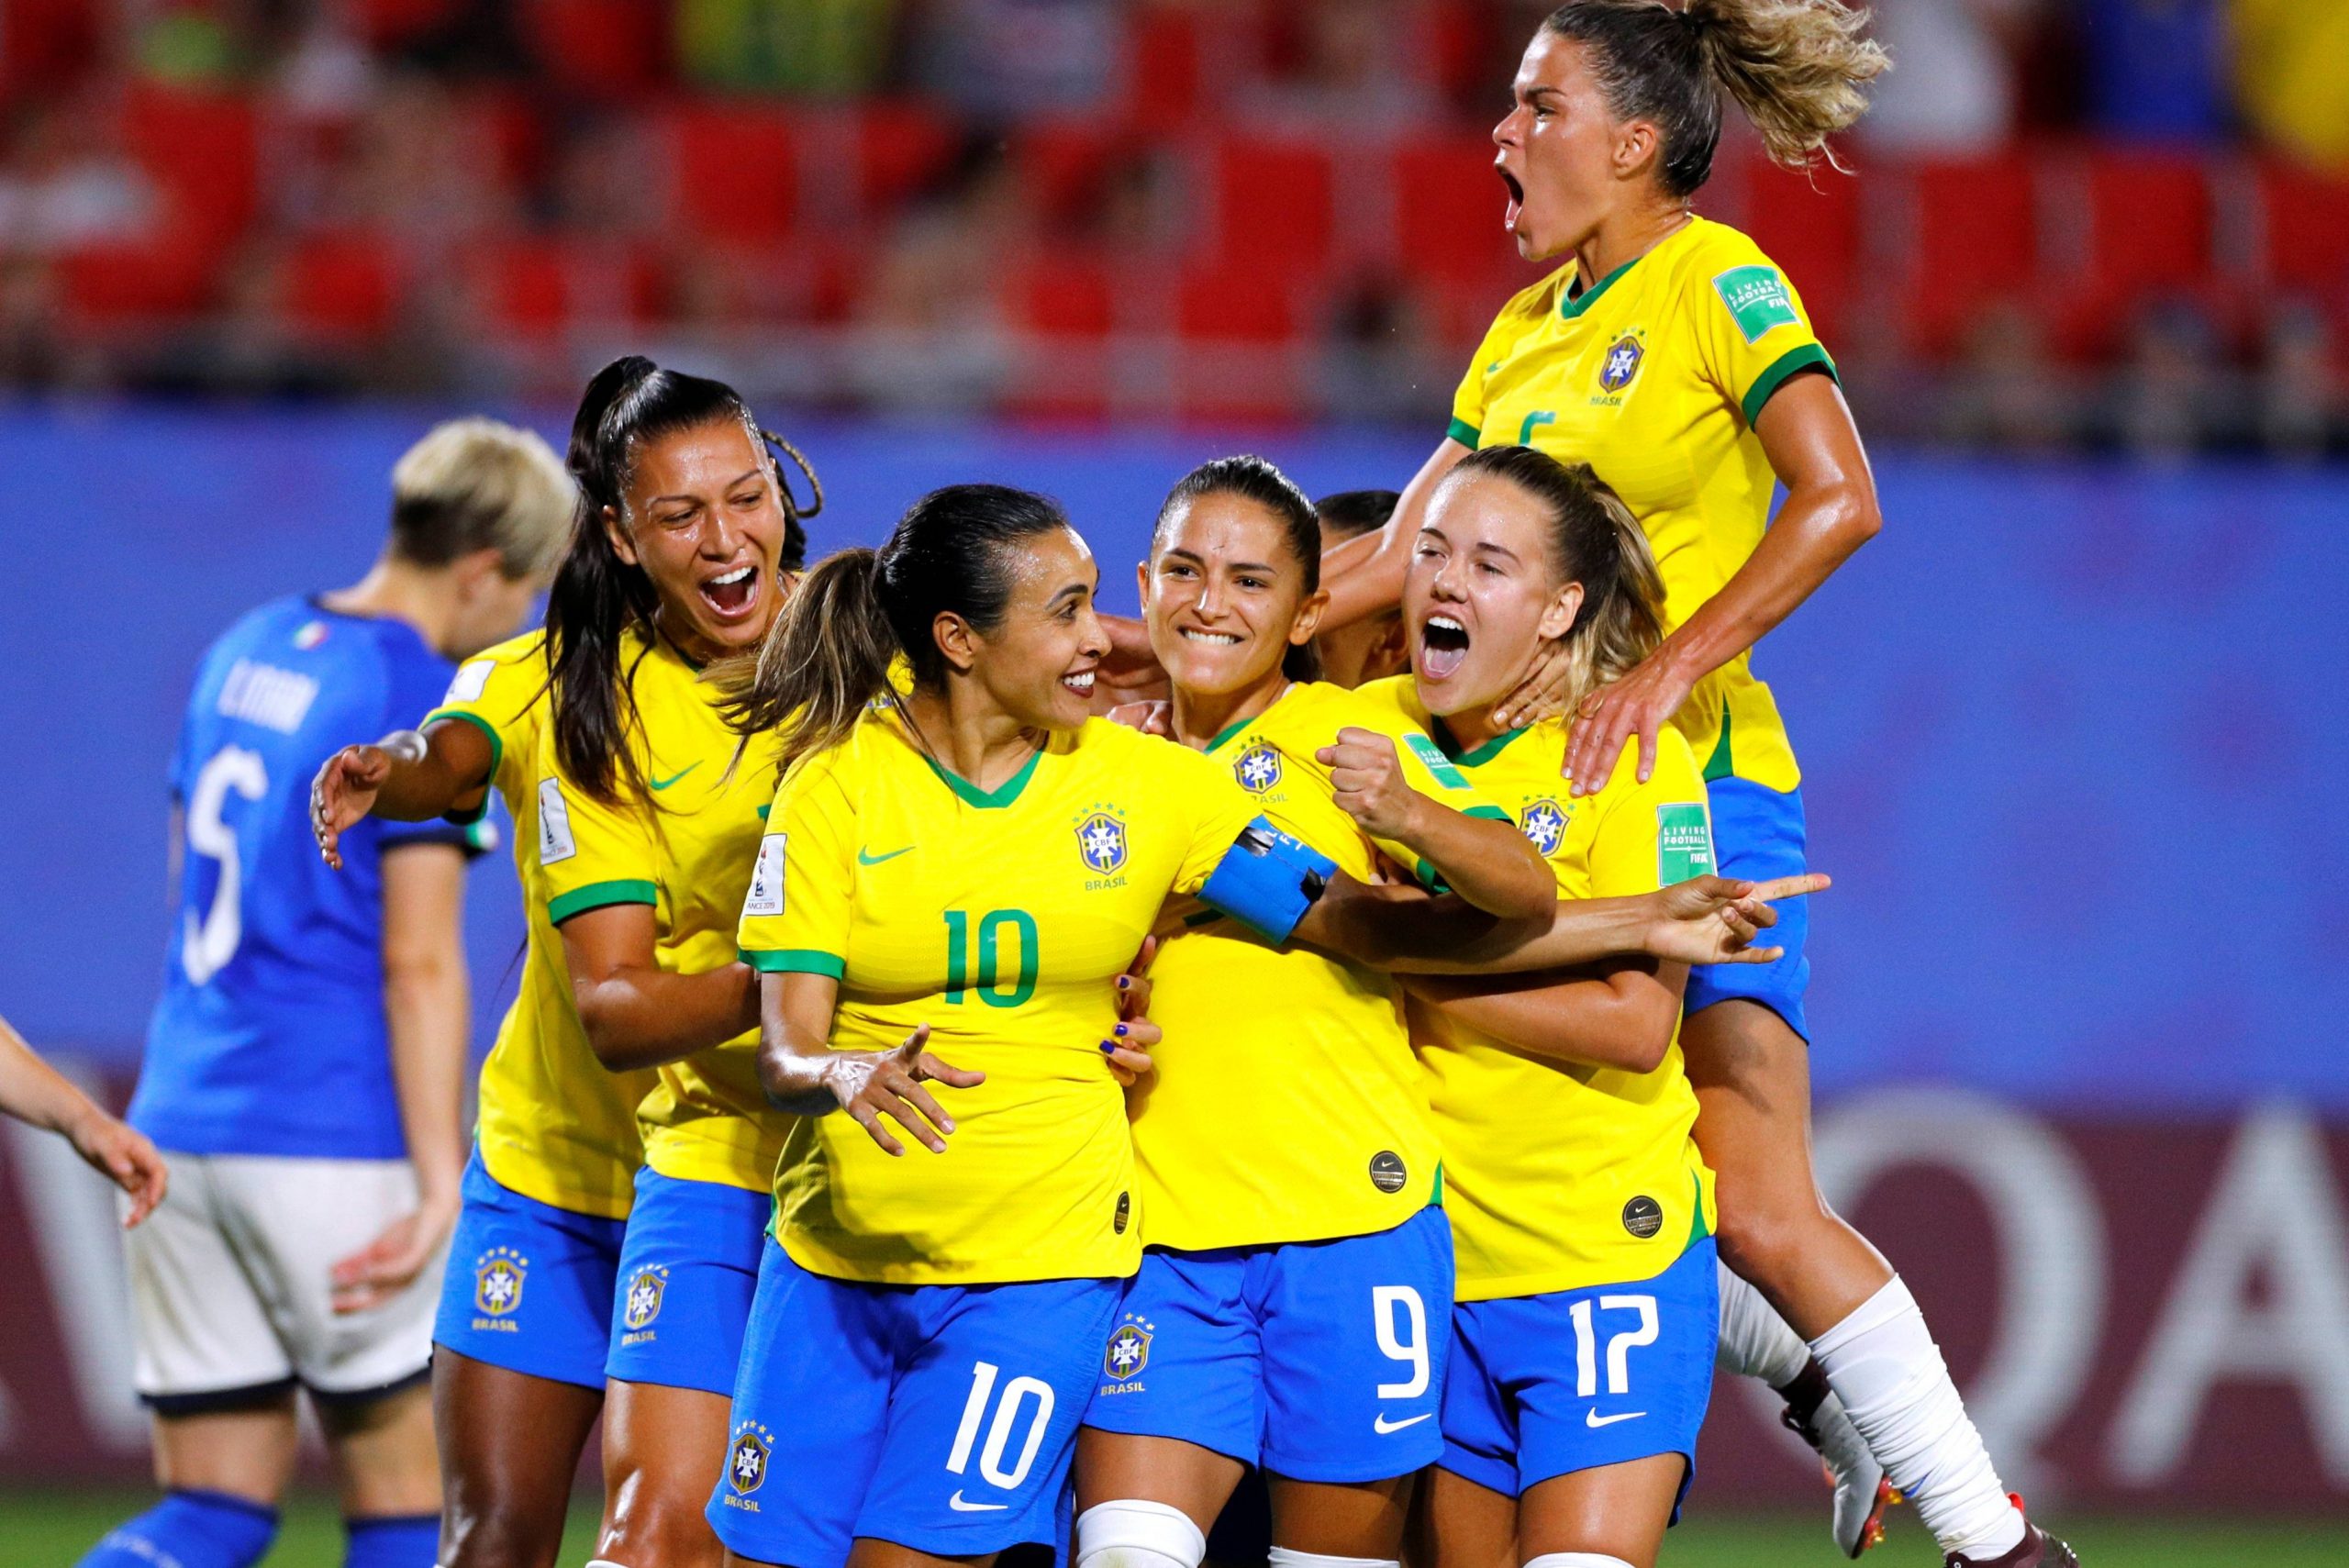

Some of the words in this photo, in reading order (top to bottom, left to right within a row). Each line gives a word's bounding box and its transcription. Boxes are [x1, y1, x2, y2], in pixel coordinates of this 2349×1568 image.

[1590, 396, 1622, 406] BRASIL
[1251, 793, 1288, 804] ASIL
[1533, 824, 1551, 833] CBF
[1664, 827, 1706, 836] LIVING
[1094, 838, 1111, 847] CBF
[1664, 836, 1707, 845] FOOTBALL
[1690, 852, 1709, 863] FIFA
[184, 744, 269, 986] 5
[1085, 875, 1129, 892] BRASIL
[943, 909, 1039, 1008] 10
[472, 1318, 519, 1332] BRASIL
[621, 1330, 657, 1346] BRASIL
[1373, 1285, 1431, 1399] 9
[1569, 1295, 1660, 1397] 17
[1101, 1382, 1145, 1396] BRASIL
[946, 1361, 1055, 1490] 10
[741, 1458, 755, 1467] CBF
[724, 1494, 761, 1512] BRASIL
